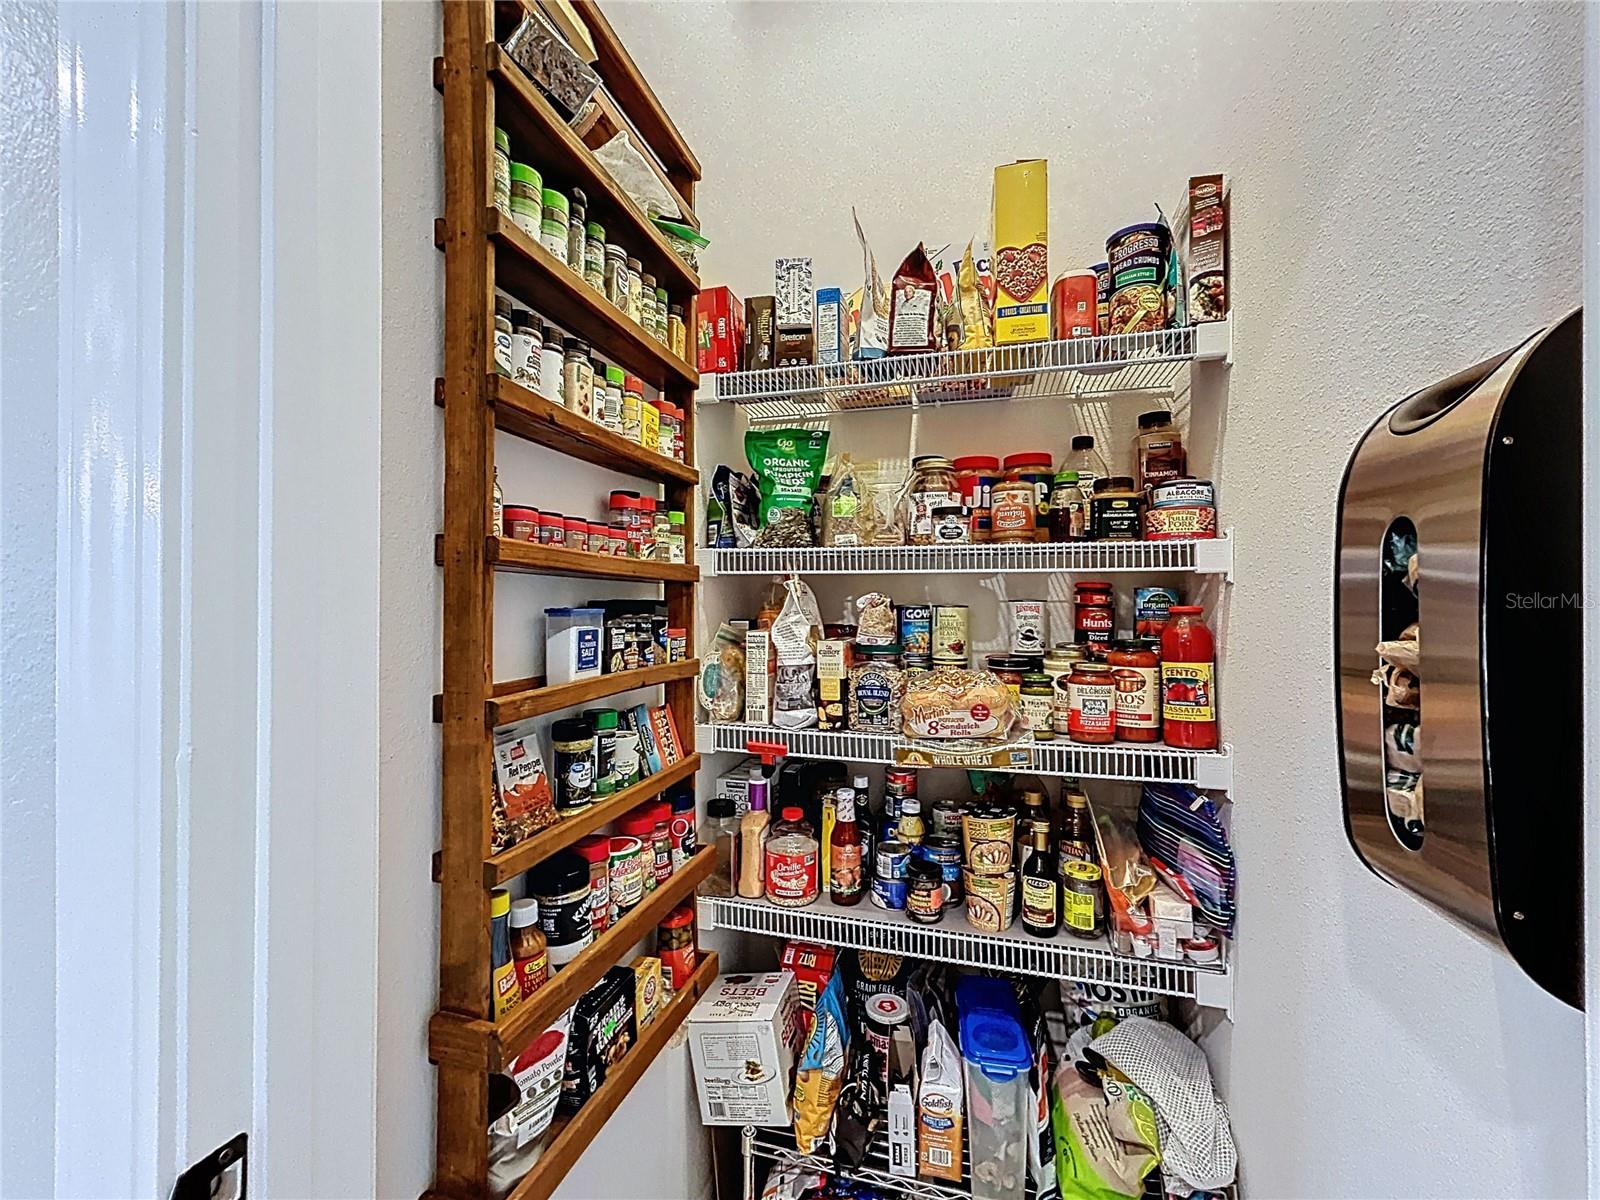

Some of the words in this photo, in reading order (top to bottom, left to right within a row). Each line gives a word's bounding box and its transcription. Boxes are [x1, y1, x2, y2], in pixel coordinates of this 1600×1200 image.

[1113, 238, 1159, 260] PROGRESSO
[1112, 258, 1132, 274] BREAD
[1133, 256, 1160, 265] CRUMBS
[780, 333, 806, 341] Breton
[763, 458, 811, 467] ORGANIC
[763, 468, 814, 479] PUMPKIN
[1144, 470, 1178, 478] CINNAMON
[775, 477, 806, 486] SEEDS
[965, 484, 991, 508] Ji
[1166, 489, 1205, 497] ALBACORE
[1168, 521, 1195, 529] PORK
[905, 608, 931, 619] GOY
[581, 648, 595, 657] SALT
[1165, 669, 1199, 677] CENTO
[857, 688, 873, 696] ROYAL
[873, 689, 889, 697] BLEND
[1117, 694, 1145, 704] AO'S
[1164, 705, 1202, 714] PASSATA
[912, 705, 950, 725] Martin's
[927, 720, 939, 736] 8
[939, 722, 980, 730] Sandwich
[932, 754, 962, 766] WHOLE
[963, 754, 993, 766] WHEAT
[508, 766, 519, 778] Red
[777, 863, 802, 872] Orville
[798, 952, 817, 968] RITZ
[719, 987, 768, 997] BEETS
[856, 980, 877, 991] GRAIN
[878, 984, 895, 994] FREE
[798, 979, 818, 1013] RITZ
[541, 1052, 565, 1072] Powder
[921, 1096, 953, 1109] Goldfish
